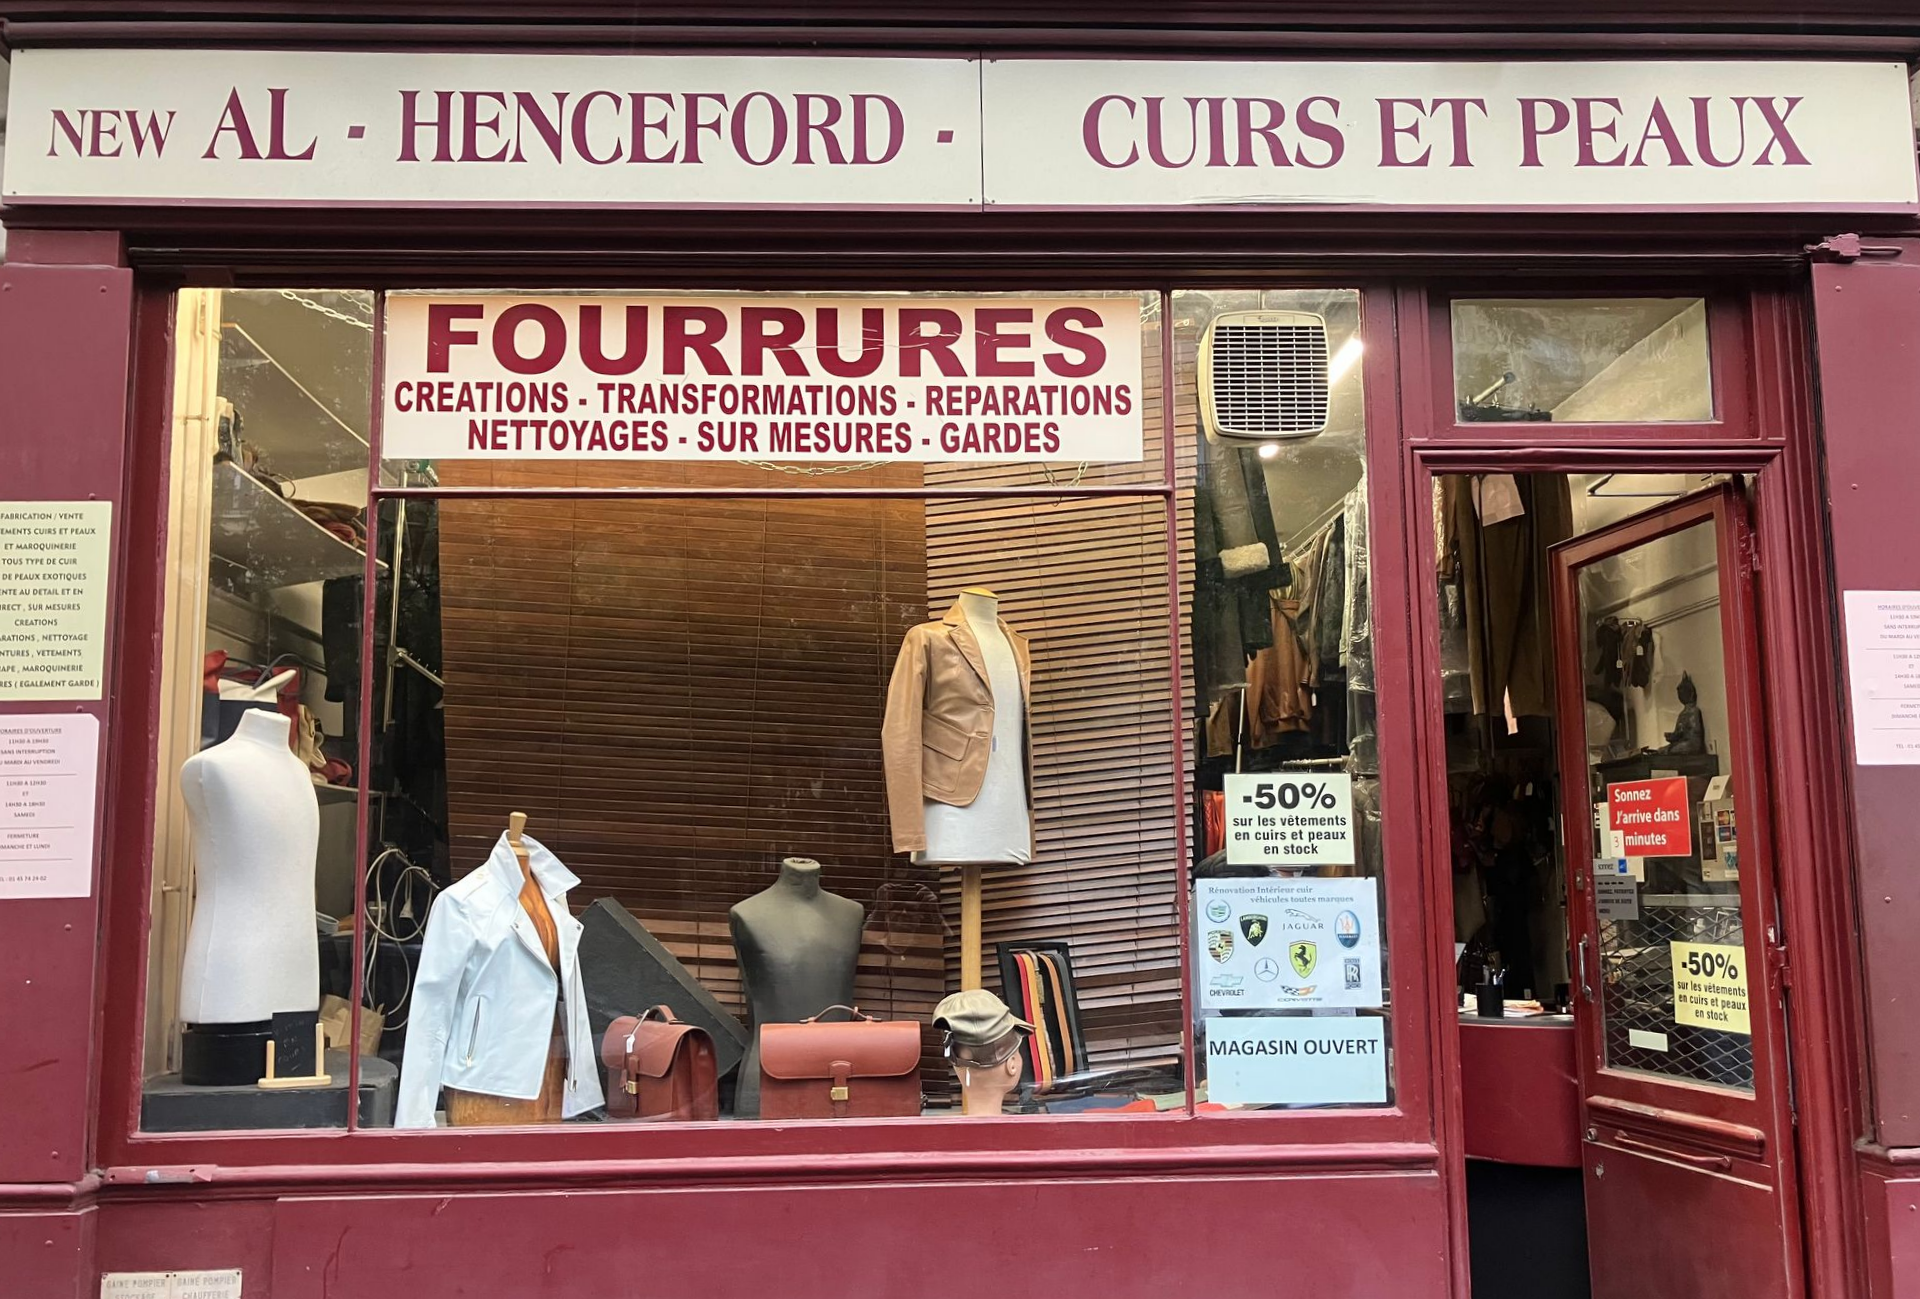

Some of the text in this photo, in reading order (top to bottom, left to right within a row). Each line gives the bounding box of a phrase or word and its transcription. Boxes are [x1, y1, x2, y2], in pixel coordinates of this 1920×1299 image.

[46, 108, 177, 160] NEW
[200, 86, 319, 162] AL
[346, 124, 367, 140] -
[394, 90, 906, 166] HENCEFORD
[1081, 94, 1813, 171] CUIRS ET PEAUX
[426, 302, 1107, 379] FOURRURES
[394, 380, 569, 414] CREATIONS
[596, 382, 898, 417] TRANSFORMATIONS
[925, 384, 1133, 417] REPARATIONS
[467, 418, 669, 452] NETTOYAGES
[697, 420, 759, 453] SUR
[769, 422, 913, 454] MESURES
[939, 422, 1061, 454] GARDES
[16, 542, 77, 552] MAROQUINERIE
[42, 572, 87, 582] EXOTIQUES
[22, 664, 84, 673] MAROQUINERIE
[1242, 782, 1337, 810] -50%
[1614, 788, 1652, 802] Sonnez
[1232, 814, 1347, 827] sur les vêtements
[1616, 808, 1680, 825] J'arrive dans
[1234, 830, 1346, 843] en cuirs et peaux
[1614, 832, 1666, 848] 3 minutes
[1264, 843, 1318, 855] en stock
[1208, 886, 1256, 894] Rénovation
[1257, 886, 1295, 894] Intérieur
[1250, 896, 1288, 904] véhicules
[1282, 922, 1324, 930] JAGUAR
[1681, 952, 1738, 980] -50%
[1677, 980, 1746, 998] sur les vêtements
[1678, 994, 1746, 1010] en cuirs et peaux
[1694, 1009, 1728, 1022] en stock
[1209, 1039, 1378, 1056] MAGASIN OUVERT
